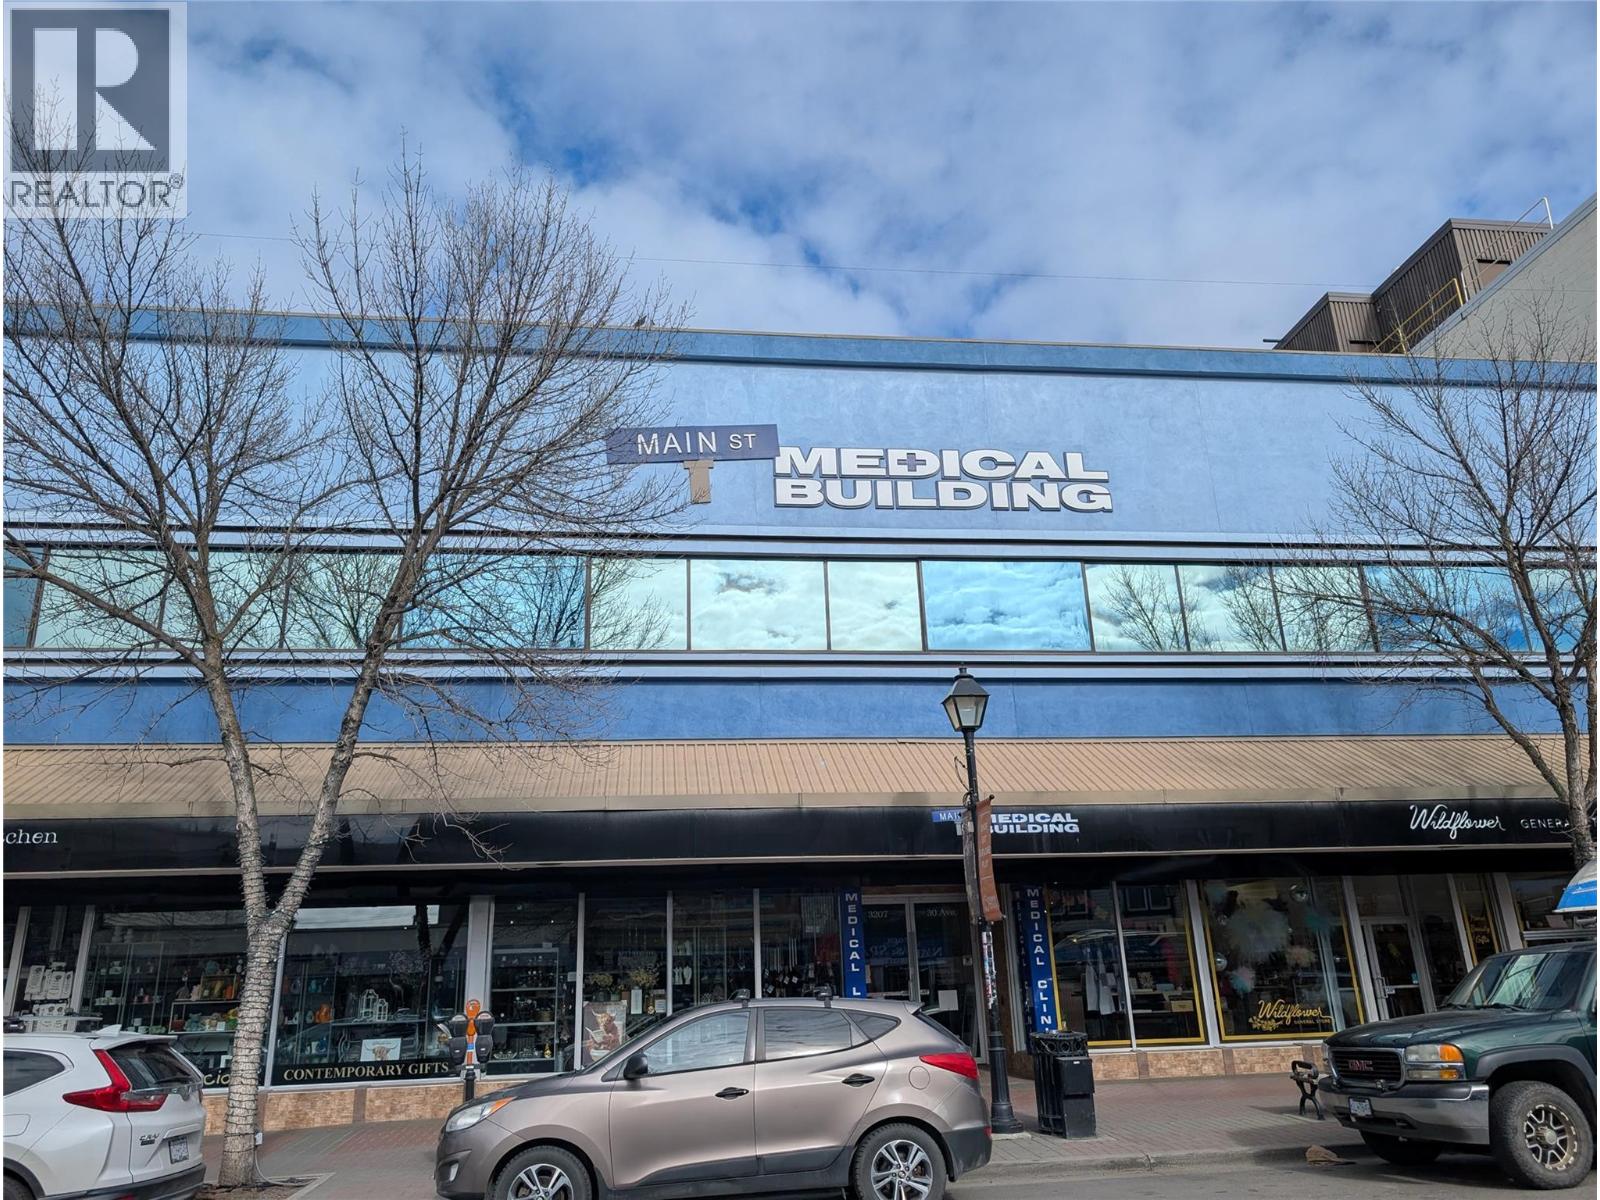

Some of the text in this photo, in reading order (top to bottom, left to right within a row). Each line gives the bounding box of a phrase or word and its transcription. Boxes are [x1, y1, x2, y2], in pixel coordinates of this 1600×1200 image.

[637, 431, 756, 455] MAIN ST
[773, 446, 1109, 483] MEDICAL
[774, 478, 1113, 513] BUILDING
[939, 812, 961, 820] MAI
[990, 823, 1079, 834] UILDING
[1409, 804, 1506, 840] Wildflower
[3, 829, 58, 844] chen
[845, 892, 860, 972] MEDICAL
[1027, 888, 1045, 966] MEDICAL
[1037, 979, 1052, 1032] CLIN
[1258, 999, 1333, 1025] Wildflower
[283, 1062, 449, 1081] CONTEMPORARY GIFTS
